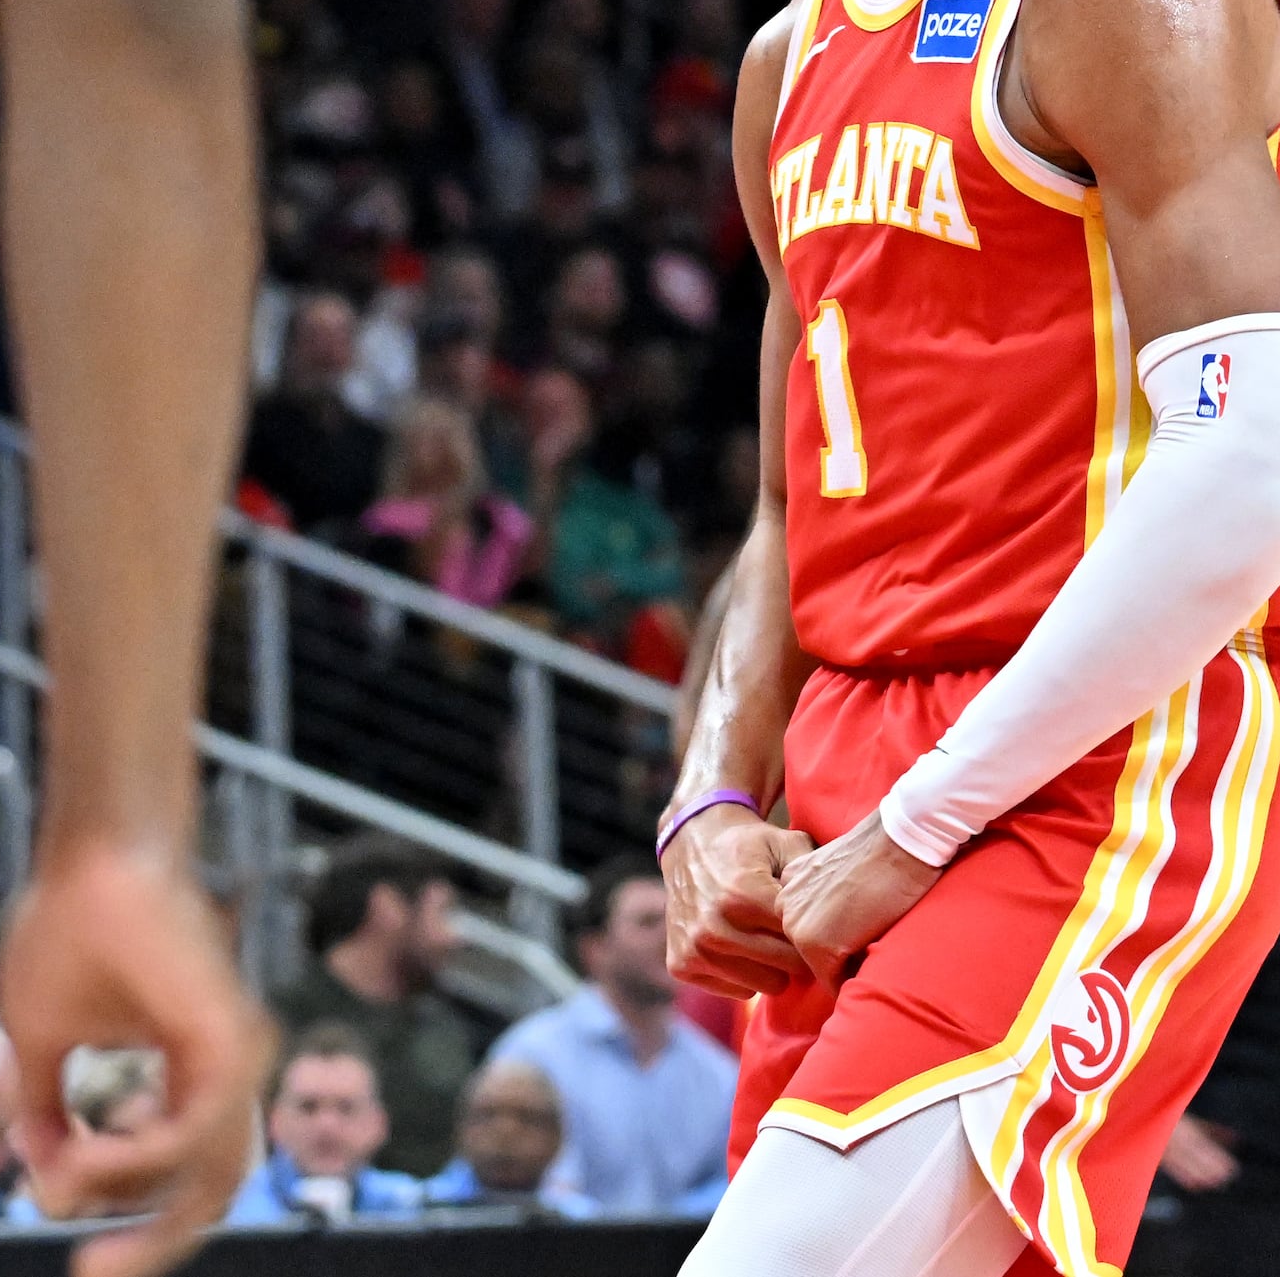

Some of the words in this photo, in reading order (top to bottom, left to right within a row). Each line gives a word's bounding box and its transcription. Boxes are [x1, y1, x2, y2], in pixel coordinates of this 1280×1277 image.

[922, 12, 982, 45] paze
[771, 121, 981, 259] TLANTA
[807, 298, 868, 499] 1
[1199, 404, 1215, 416] NBA
